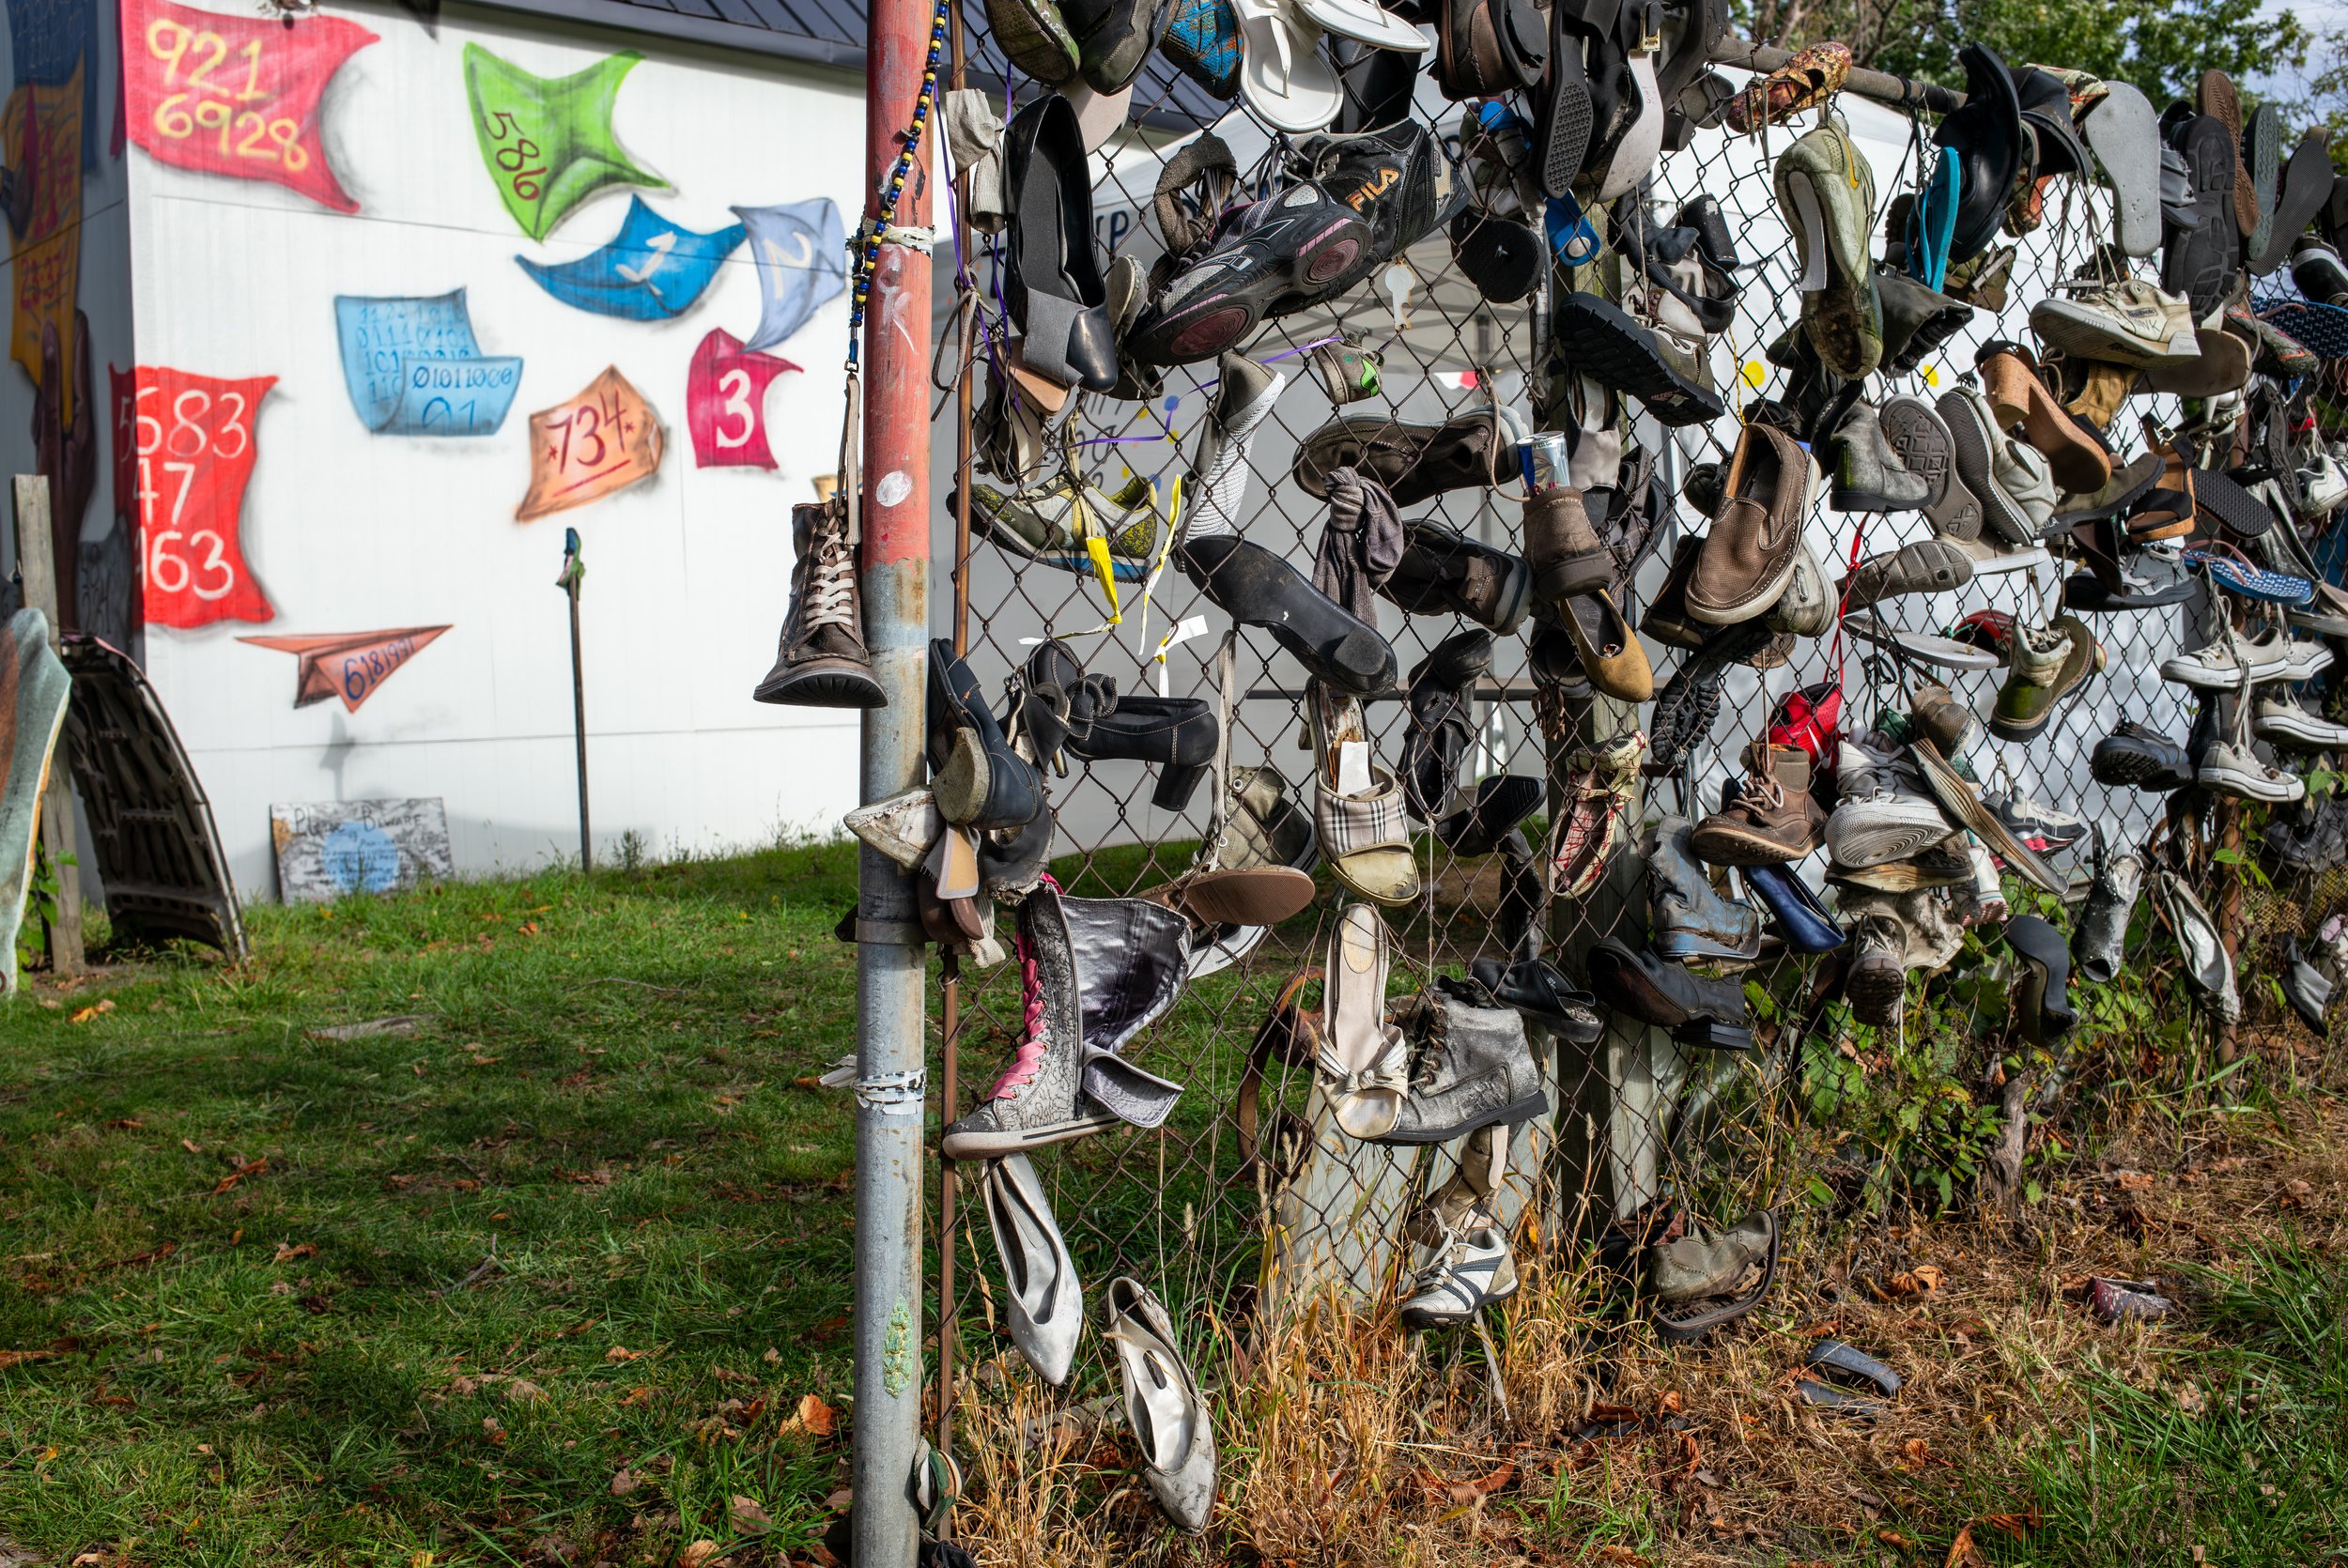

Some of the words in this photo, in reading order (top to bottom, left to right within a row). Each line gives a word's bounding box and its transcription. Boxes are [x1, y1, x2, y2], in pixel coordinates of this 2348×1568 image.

[147, 19, 267, 100] 921
[153, 93, 309, 171] 6928
[484, 110, 548, 201] 586
[1345, 168, 1399, 212] FILA
[545, 388, 628, 474] 734
[717, 368, 754, 448] 3
[344, 636, 416, 700] 6181991
